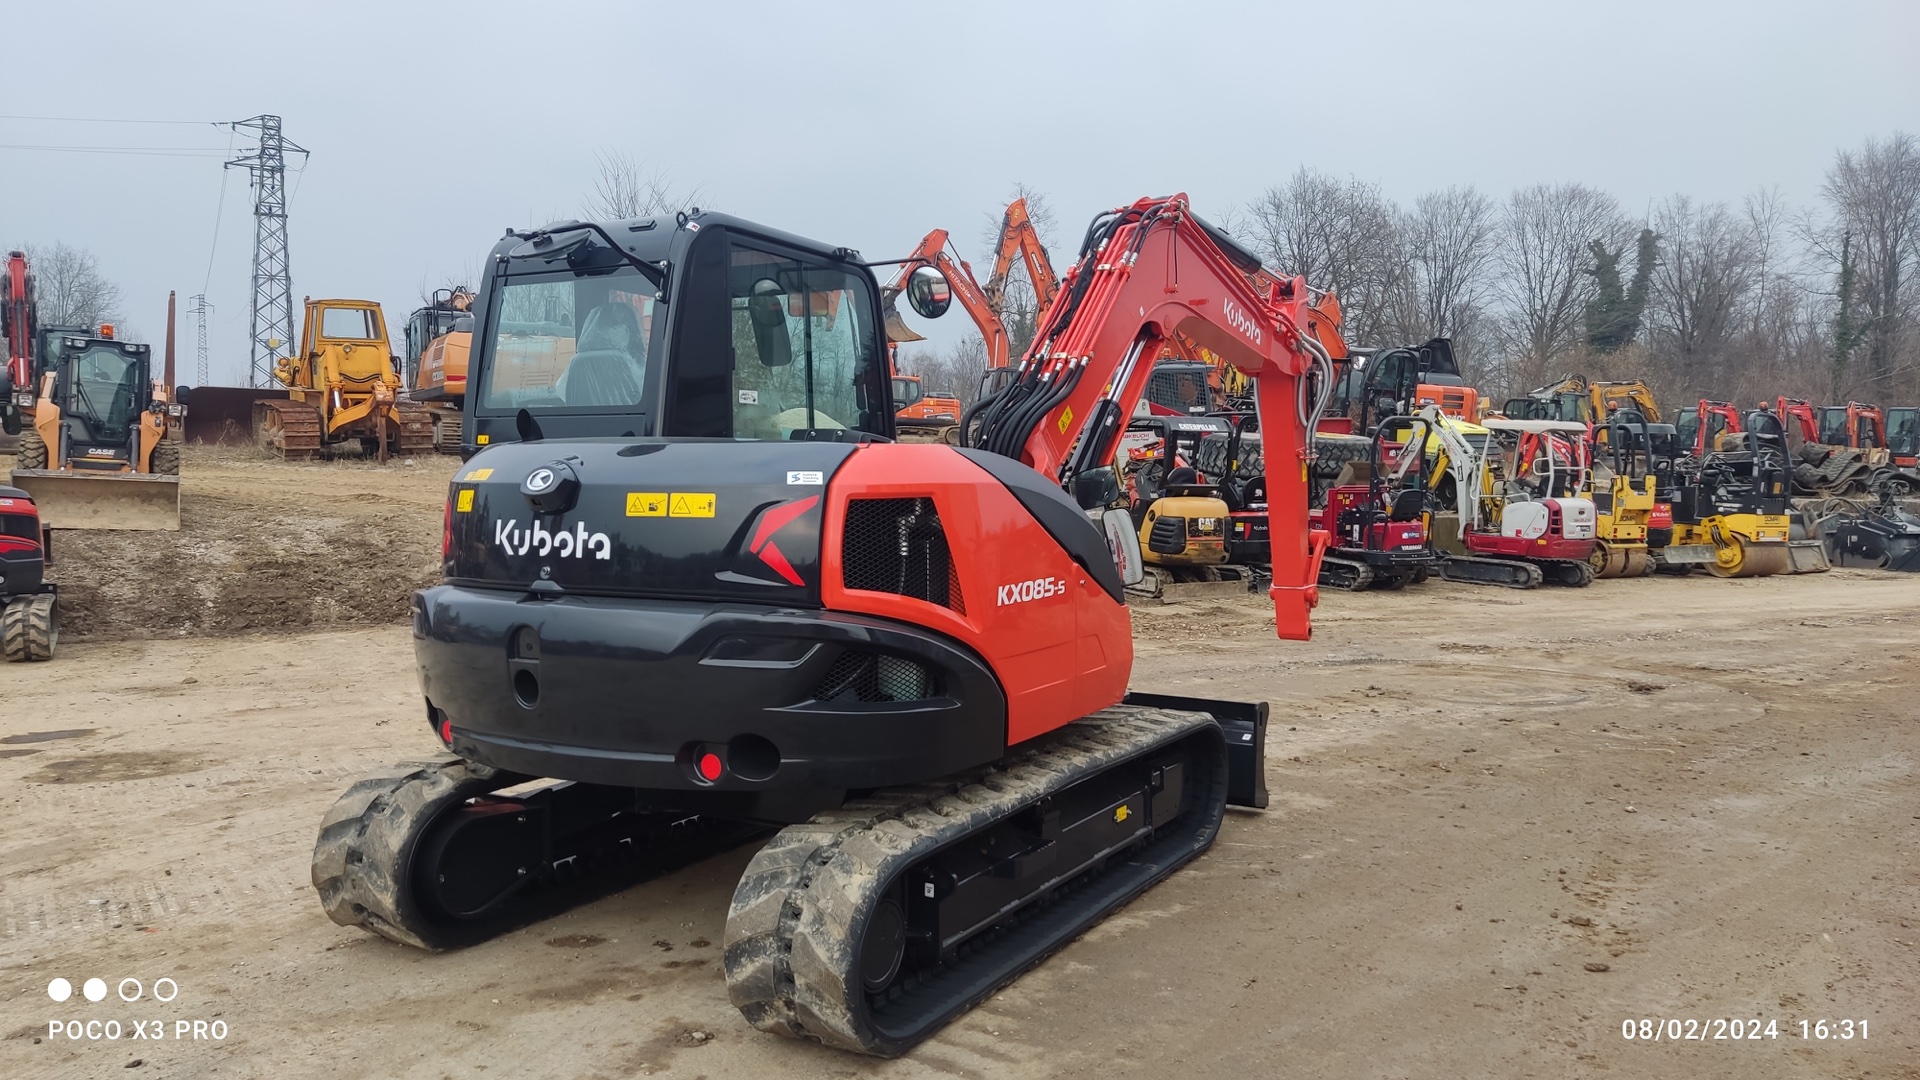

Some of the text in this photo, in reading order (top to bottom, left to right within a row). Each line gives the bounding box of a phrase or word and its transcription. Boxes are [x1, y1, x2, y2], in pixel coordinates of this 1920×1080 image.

[948, 270, 971, 298] HITACHI
[1223, 297, 1261, 346] Kubota
[1178, 423, 1218, 431] CATERPILLAR
[88, 448, 116, 456] CASE
[1198, 517, 1216, 530] CAT
[495, 519, 611, 560] Kubota
[997, 577, 1066, 607] KX085-5
